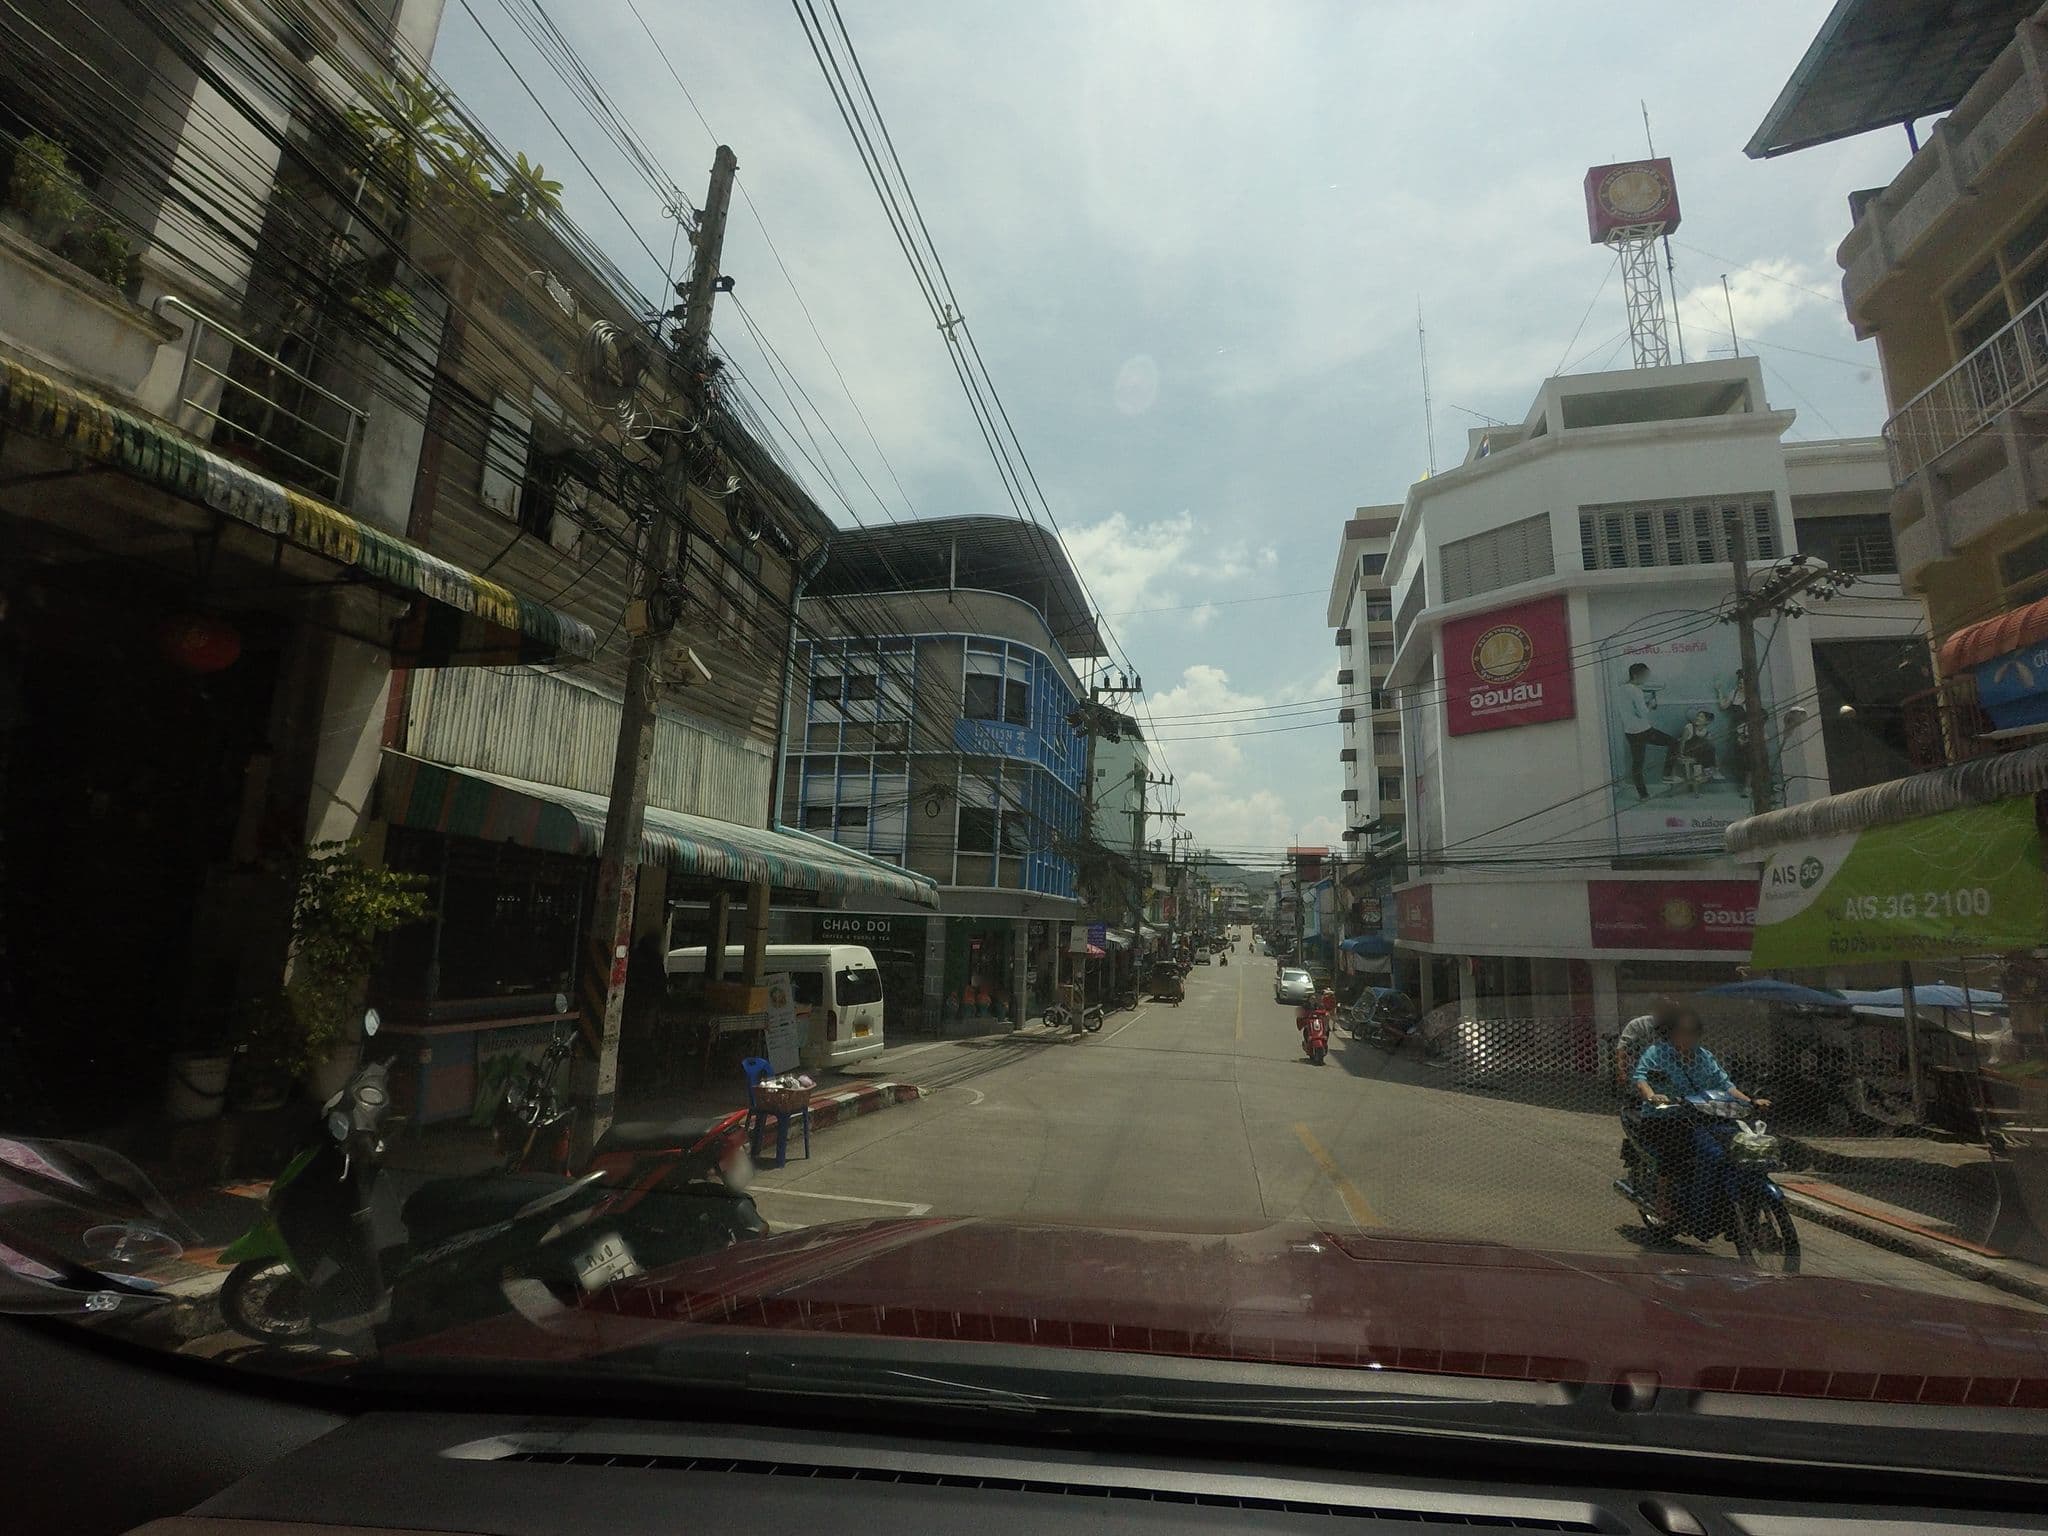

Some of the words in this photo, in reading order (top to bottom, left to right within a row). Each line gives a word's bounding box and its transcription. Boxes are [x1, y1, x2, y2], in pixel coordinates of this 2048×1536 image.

[1469, 681, 1543, 709] ออมสิน
[1771, 865, 1797, 887] AIS
[1800, 861, 1821, 881] 3G
[1845, 895, 1878, 921] AIS
[1883, 894, 1916, 920] 3G
[1924, 887, 1991, 919] 2100
[822, 919, 861, 931] CHAO
[867, 920, 891, 932] DOI
